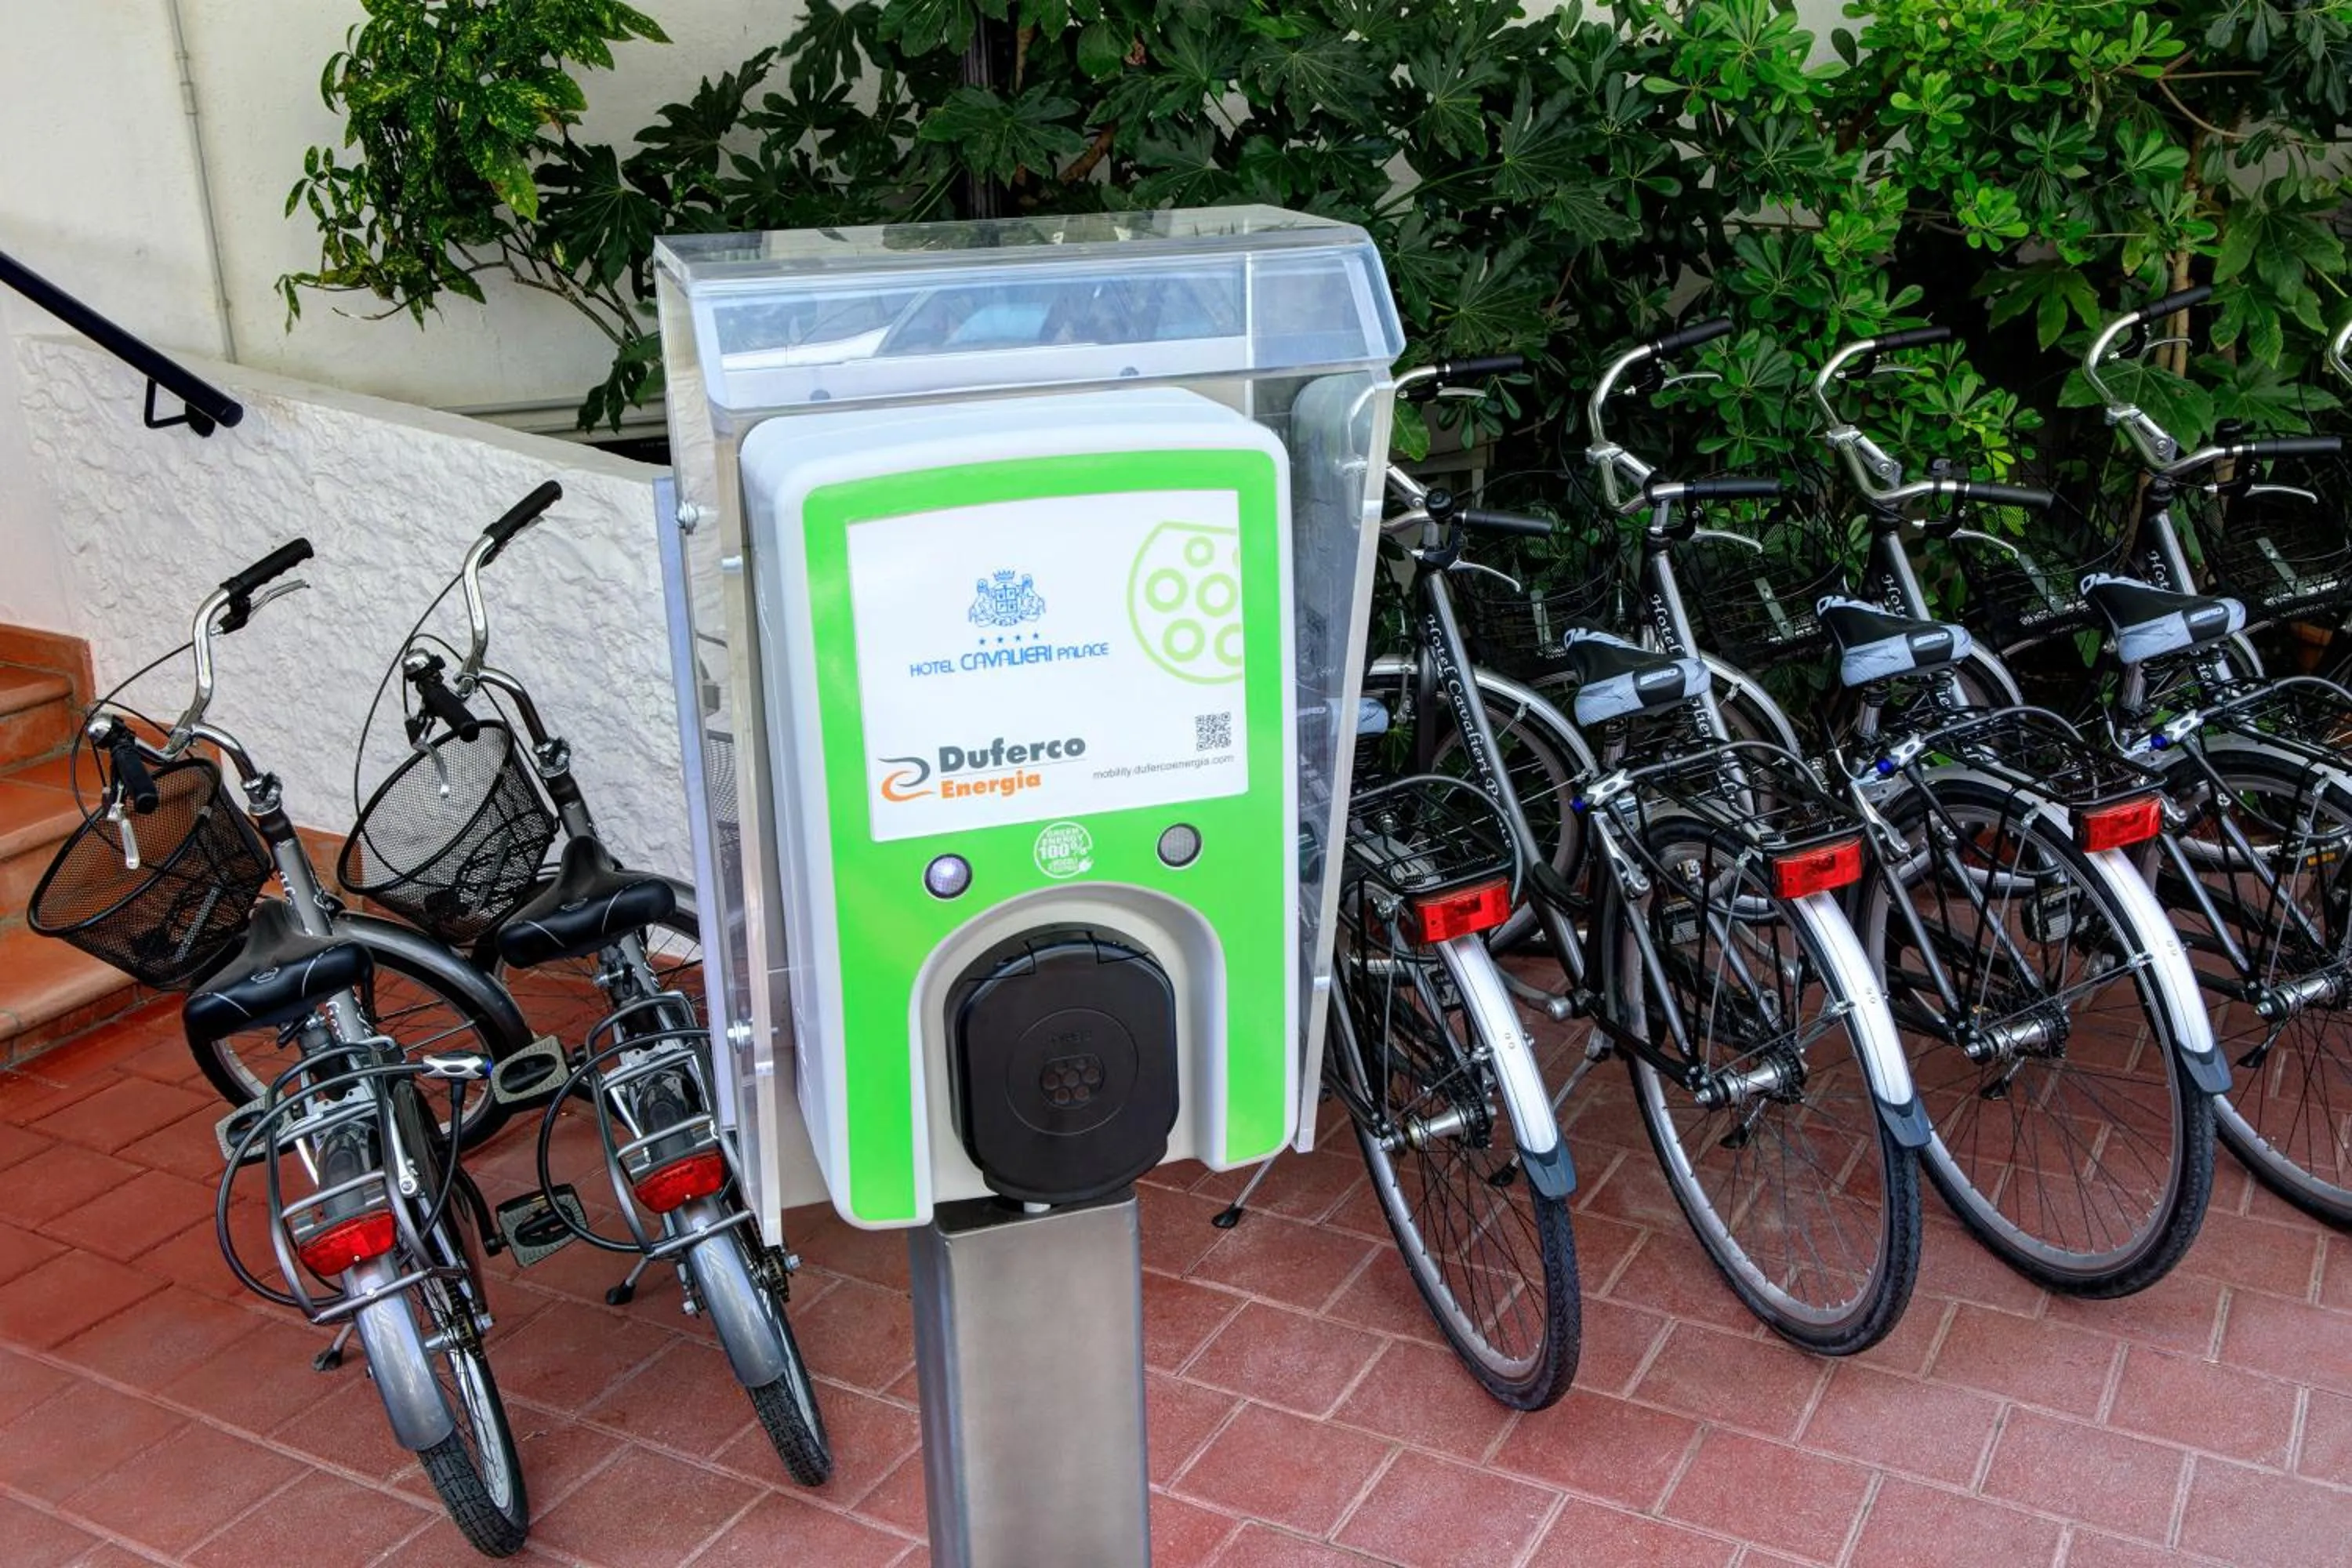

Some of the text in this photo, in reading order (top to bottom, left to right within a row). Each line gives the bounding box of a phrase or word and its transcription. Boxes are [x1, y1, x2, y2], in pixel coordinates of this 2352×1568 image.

[909, 642, 1110, 677] HOTEL CAVALIERI PALACE
[1428, 614, 1458, 674] Hotel
[938, 737, 1086, 773] Duferco
[942, 769, 1041, 799] Energia
